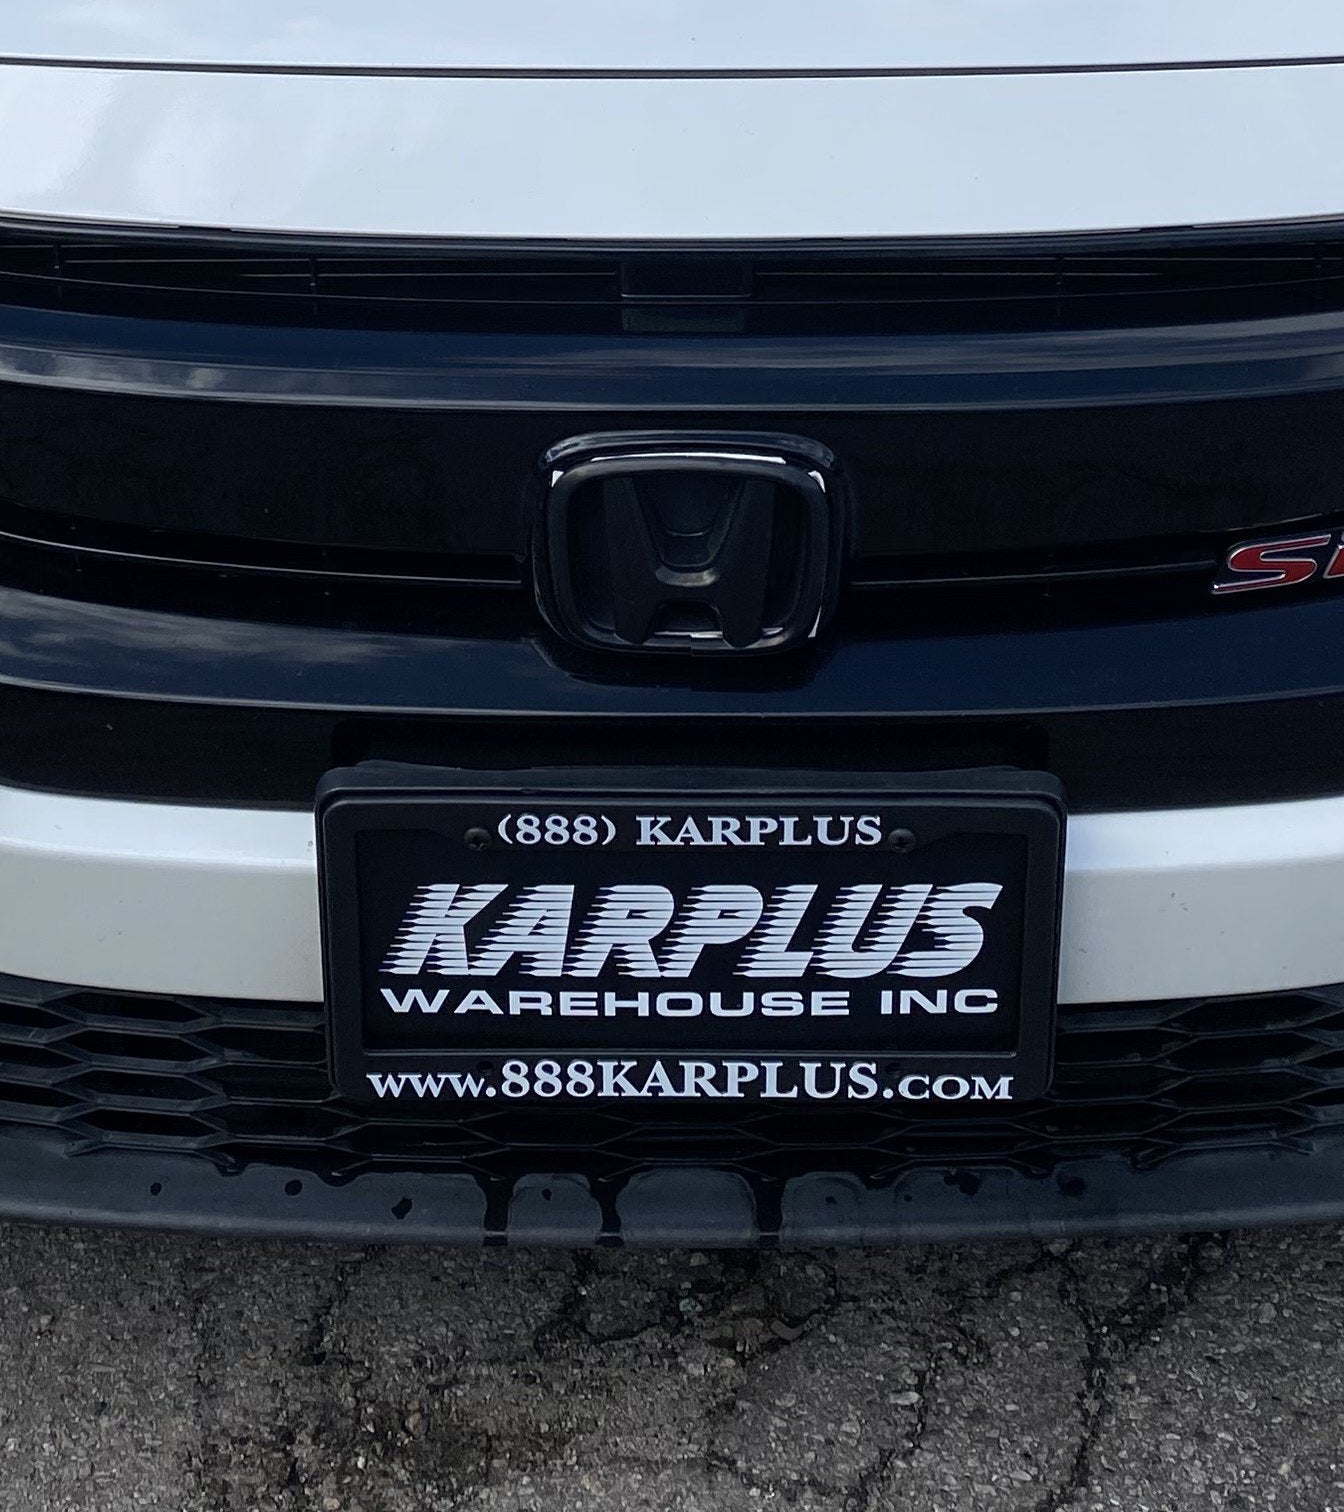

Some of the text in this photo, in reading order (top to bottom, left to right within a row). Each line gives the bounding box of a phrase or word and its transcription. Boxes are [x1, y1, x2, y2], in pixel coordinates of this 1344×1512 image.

[496, 813, 882, 847] (888) KARPLUS
[378, 882, 1004, 979] KARPLUS
[380, 988, 998, 1018] WAREHOUSE INC
